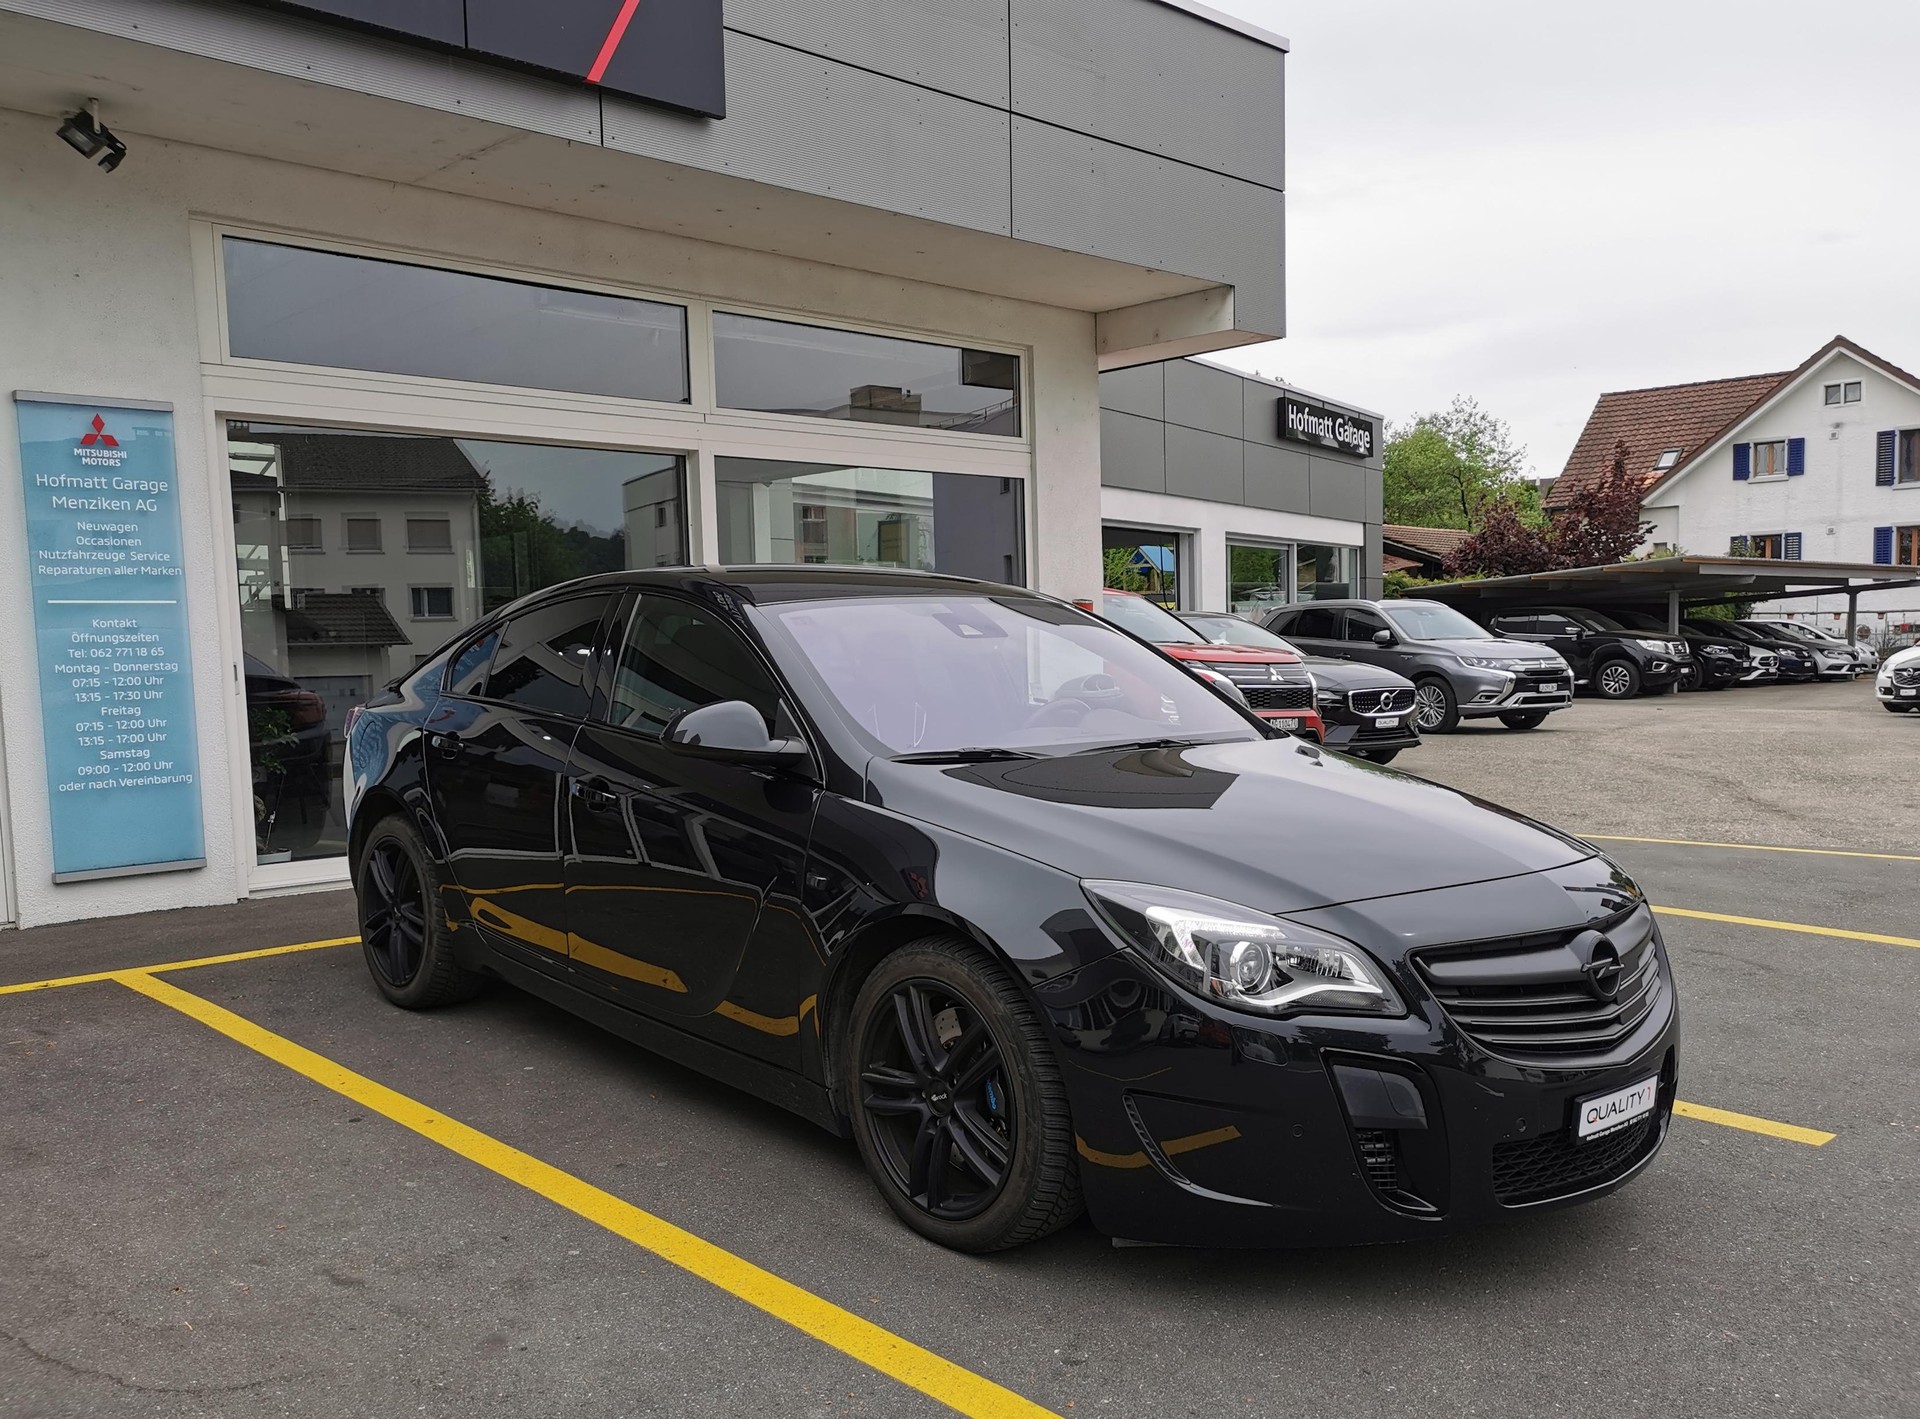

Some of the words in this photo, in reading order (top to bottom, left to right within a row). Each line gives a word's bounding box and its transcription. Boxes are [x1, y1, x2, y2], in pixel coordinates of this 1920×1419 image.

[1288, 404, 1334, 439] Hofmatt
[1335, 417, 1371, 453] Garage
[73, 447, 128, 459] MITSUBISHI
[81, 457, 122, 468] MOTORS
[35, 473, 108, 490] Hofmatt
[112, 476, 169, 494] Garage
[51, 495, 131, 511] Menziken
[135, 498, 158, 512] AG
[76, 520, 139, 534] Neuwagen
[75, 535, 143, 547] Occasionen
[38, 549, 126, 563] Nutzfahrzeuge
[129, 550, 171, 562] Service
[37, 564, 112, 576] Reparaturen
[113, 565, 138, 576] aller
[139, 566, 183, 577] Marken
[91, 618, 138, 629] Kontakt
[71, 631, 160, 645] Öffnungszeiten
[67, 648, 88, 659] Tel:
[90, 648, 113, 658] 062
[150, 646, 165, 657] 65
[54, 663, 101, 675] Montag
[112, 661, 179, 673] Donnerstag
[71, 677, 101, 689] 07:15
[112, 676, 142, 687] 12:00
[144, 675, 165, 686] Uhr
[74, 692, 102, 703] 13:15
[112, 691, 142, 701] 17:30
[143, 689, 164, 700] Uhr
[100, 705, 142, 717] Freitag
[75, 721, 104, 733] 07:15
[115, 718, 145, 730] 12:00
[147, 718, 168, 728] Uhr
[77, 735, 105, 747] 13:15
[115, 733, 145, 744] 17:00
[147, 732, 168, 743] Uhr
[99, 748, 151, 761] Samstag
[77, 764, 111, 776] 09:00
[121, 761, 151, 773] 12:00
[153, 759, 174, 770] Uhr
[58, 782, 86, 793] oder
[88, 778, 117, 790] nach
[118, 773, 194, 789] Vereinbarung
